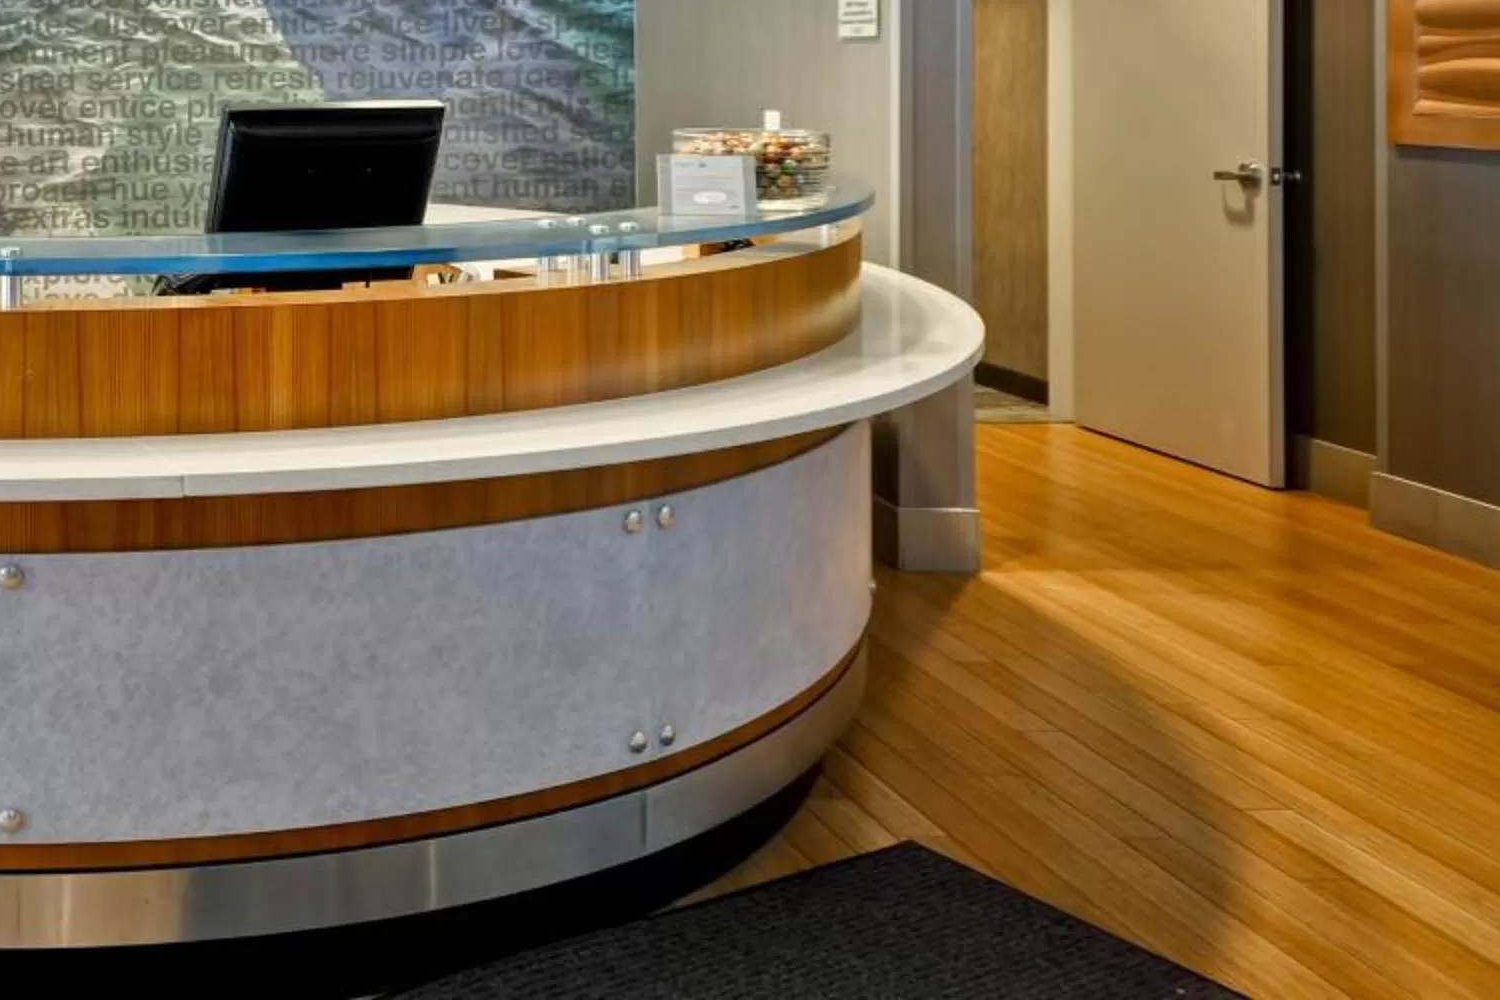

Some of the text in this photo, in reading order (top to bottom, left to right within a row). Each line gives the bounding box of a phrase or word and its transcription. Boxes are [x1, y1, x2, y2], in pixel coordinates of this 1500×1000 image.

[242, 10, 335, 34] entice
[294, 44, 369, 62] more
[382, 38, 486, 68] simple
[87, 66, 200, 90] service
[214, 66, 323, 90] refresh
[337, 65, 503, 95] rejuvenate
[80, 94, 176, 118] entice
[8, 121, 200, 151] human style
[116, 176, 169, 200] hue
